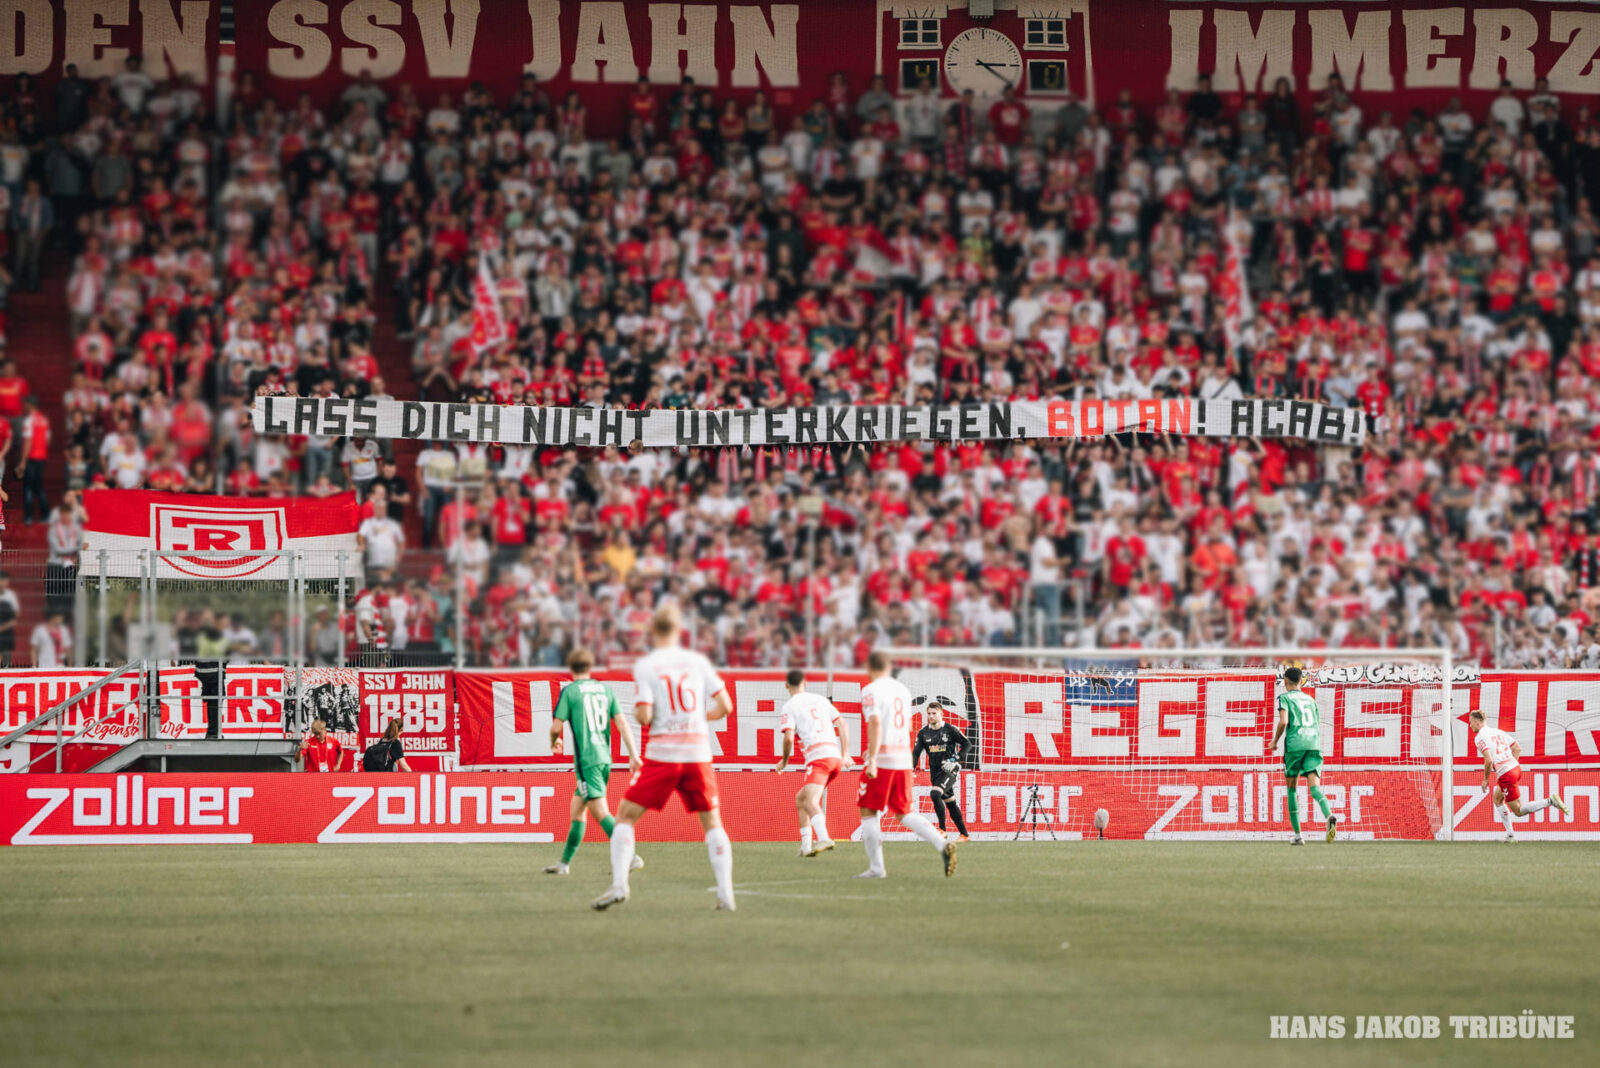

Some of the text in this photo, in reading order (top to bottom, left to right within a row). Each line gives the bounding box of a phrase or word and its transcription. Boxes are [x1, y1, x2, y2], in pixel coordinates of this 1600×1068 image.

[267, 0, 481, 80] SSV
[523, 0, 799, 88] JAHN
[263, 396, 1360, 445] LASS DICH NICHT UNTERKRIEGEN, BOTAN! ACAB!
[364, 673, 446, 690] SSV JAHN
[658, 673, 697, 715] 16
[365, 693, 446, 733] 1889
[583, 694, 608, 732] 18
[810, 708, 825, 733] 5
[893, 697, 904, 729] 8
